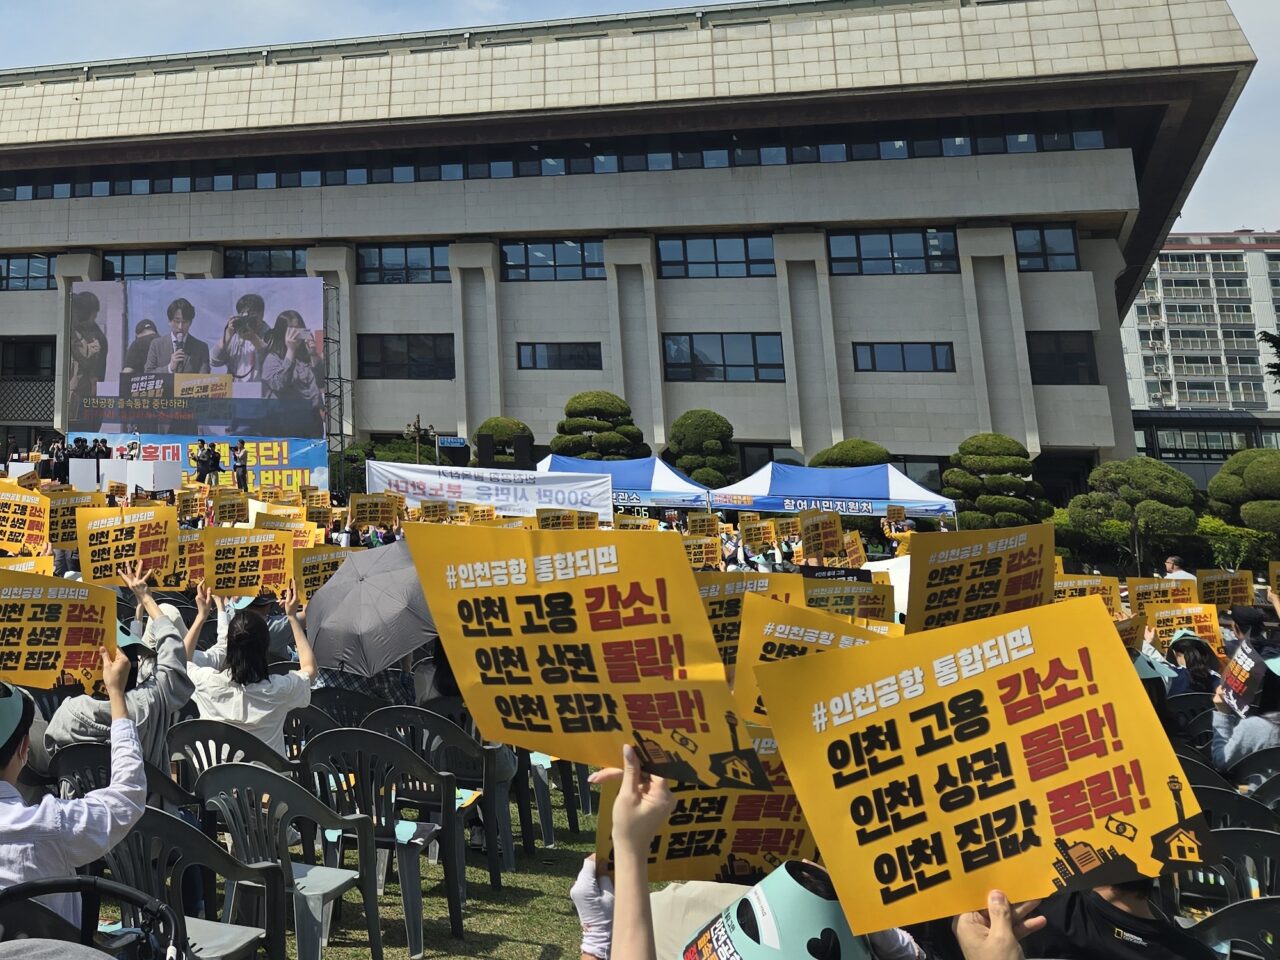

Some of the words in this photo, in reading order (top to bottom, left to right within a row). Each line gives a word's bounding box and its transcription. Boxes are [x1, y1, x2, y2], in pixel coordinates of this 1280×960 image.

[82, 398, 115, 408] 인천공항
[152, 399, 188, 410] 중단하라!
[446, 559, 527, 590] #인천공항
[533, 546, 618, 584] 통합되면
[48, 588, 90, 600] 통합되면
[458, 597, 512, 638] 인천
[515, 592, 576, 636] 고용
[587, 580, 668, 631] 감소!
[27, 604, 63, 622] 고용
[67, 605, 106, 623] 감소!
[27, 627, 62, 646] 상권
[65, 628, 106, 646] 몰락!
[763, 622, 836, 646] #인천공항
[24, 651, 61, 671] 집값
[476, 647, 533, 686] 인천
[537, 644, 599, 684] 상권
[602, 636, 686, 684] 몰락!
[812, 666, 924, 731] #인천공항
[933, 626, 1033, 686] 통합되면
[495, 695, 550, 730] 인천
[554, 692, 621, 733] 집값
[623, 692, 707, 733] 폭락!
[828, 719, 902, 787] 인천
[910, 690, 988, 755] 고용
[999, 649, 1095, 722] 감소!
[850, 775, 926, 844] 인천
[934, 742, 1014, 811] 상권
[1022, 704, 1120, 779] 몰락!
[669, 796, 727, 826] 상권
[733, 795, 807, 821] 몰락!
[666, 829, 727, 859] 집값
[732, 829, 804, 855] 폭락!
[874, 832, 949, 903] 인천
[954, 800, 1039, 871] 집값
[1047, 761, 1147, 833] 폭락!
